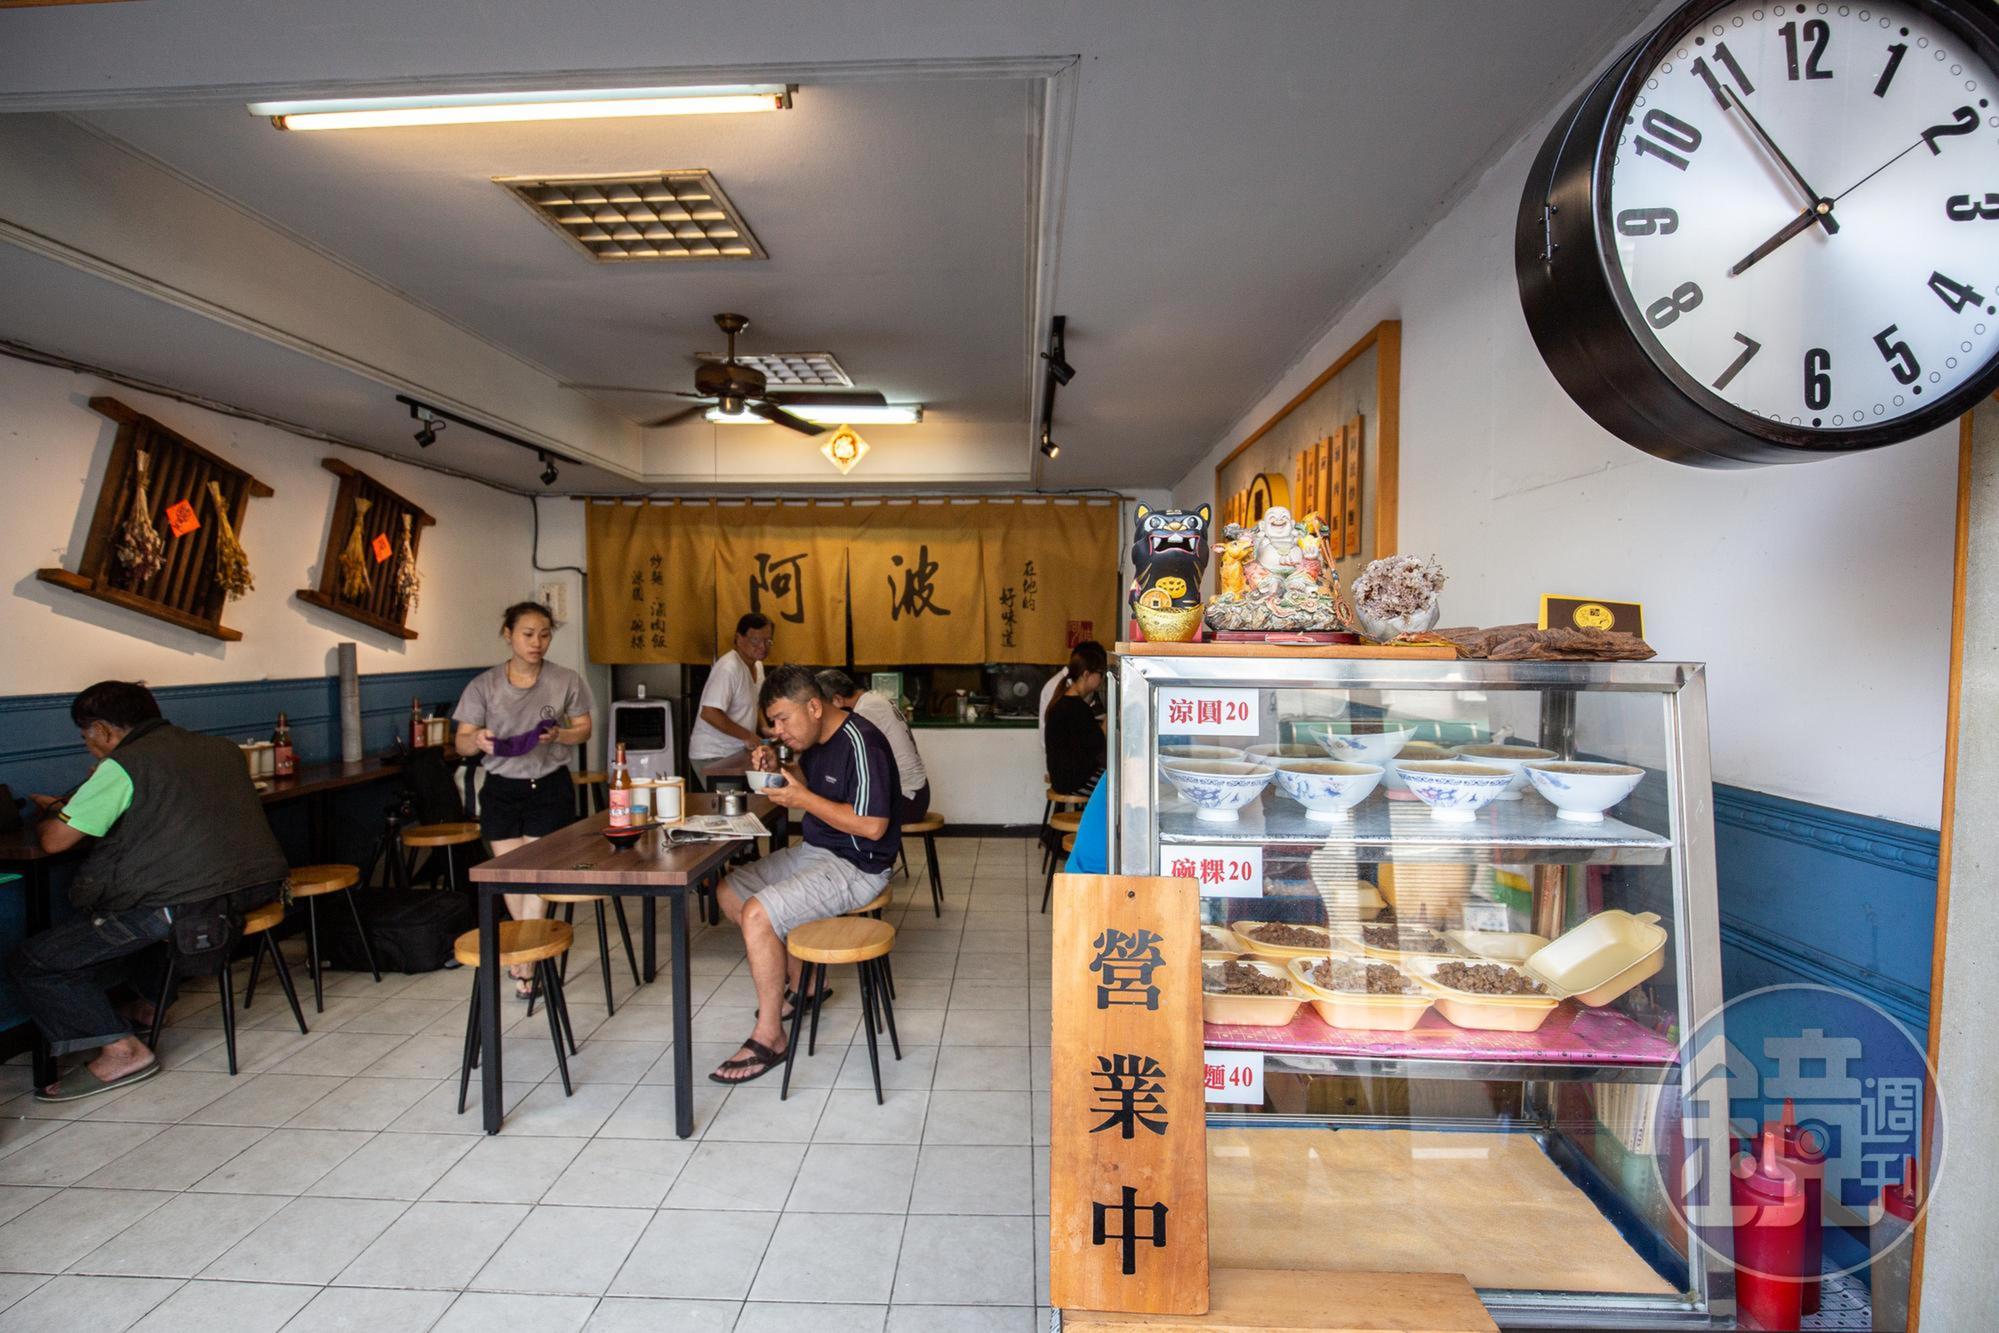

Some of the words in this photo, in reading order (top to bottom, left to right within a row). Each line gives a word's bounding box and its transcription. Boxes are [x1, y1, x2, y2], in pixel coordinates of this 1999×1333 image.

[1690, 41, 1755, 111] 11
[1778, 18, 1833, 80] 12
[1873, 42, 1908, 98] 1
[1633, 108, 1703, 171] 10
[1920, 105, 1980, 156] 2
[1617, 207, 1679, 236] 9
[1945, 193, 1999, 222] 3
[1645, 281, 1704, 330] 8
[1928, 271, 1985, 314] 4
[1712, 331, 1762, 391] 7
[1804, 348, 1832, 411] 6
[1873, 324, 1921, 385] 5
[1089, 928, 1169, 1275] 營業中
